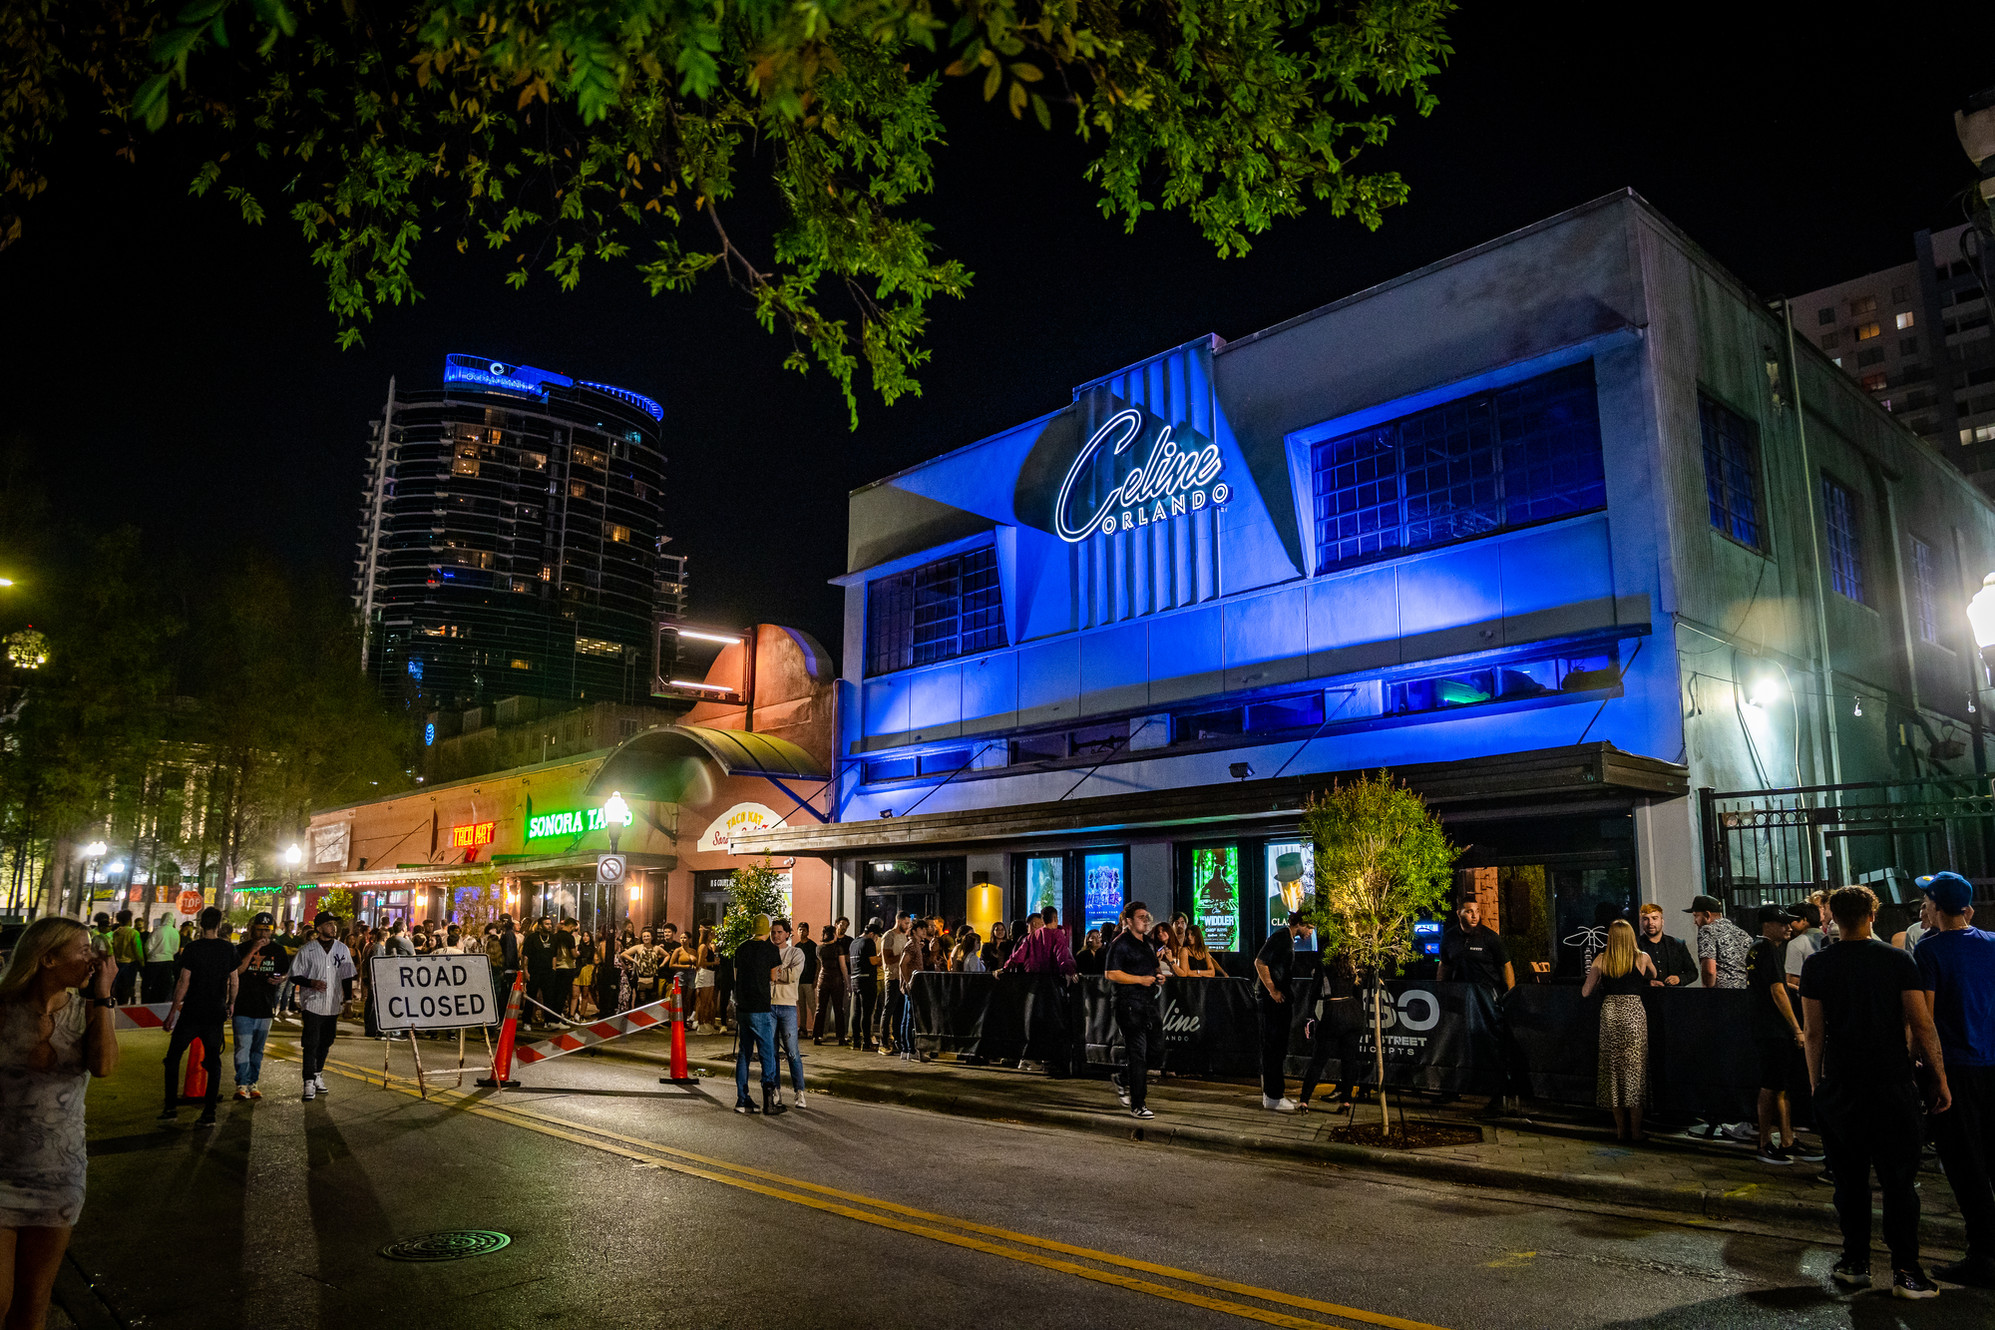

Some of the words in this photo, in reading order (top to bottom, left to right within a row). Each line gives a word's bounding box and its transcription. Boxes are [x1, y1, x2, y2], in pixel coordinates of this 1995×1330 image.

[1055, 409, 1222, 543] Celine
[1102, 483, 1229, 535] ORLANDO
[529, 811, 583, 838] SONORA
[588, 808, 634, 830] TAS
[726, 811, 746, 829] TACO
[747, 811, 764, 825] KAT
[180, 899, 200, 909] STOP
[1204, 915, 1235, 926] WIDDLER
[1271, 918, 1291, 927] CLA
[399, 965, 468, 988] ROAD
[388, 994, 486, 1018] CLOSED
[1162, 999, 1201, 1032] line
